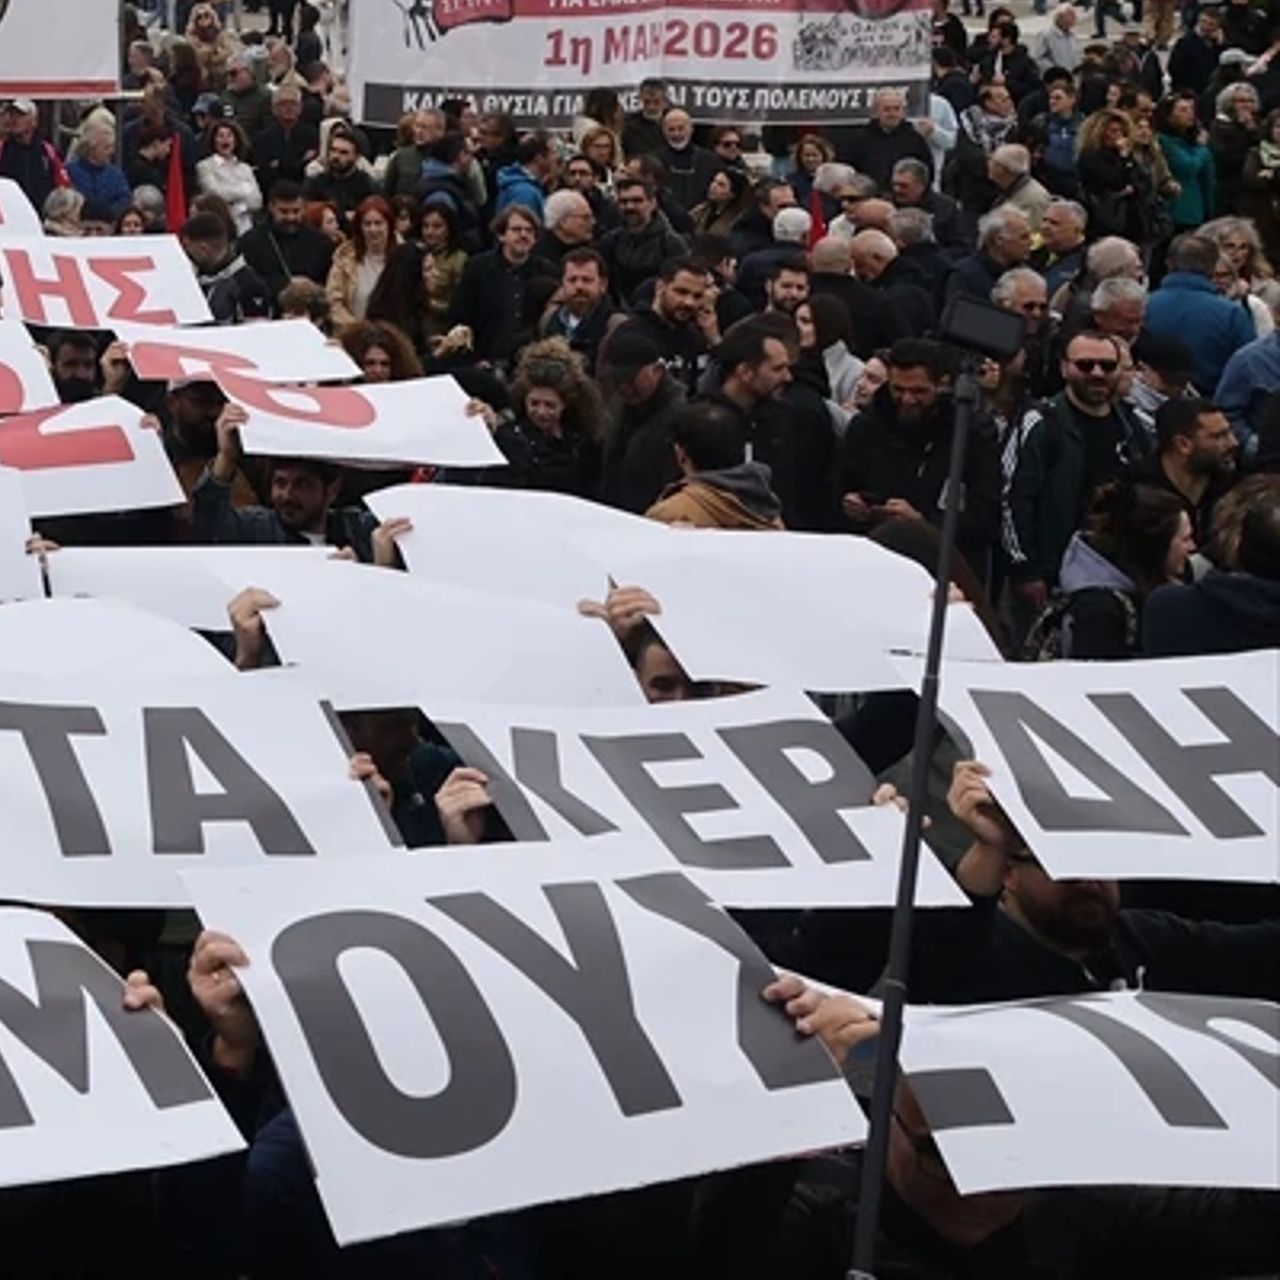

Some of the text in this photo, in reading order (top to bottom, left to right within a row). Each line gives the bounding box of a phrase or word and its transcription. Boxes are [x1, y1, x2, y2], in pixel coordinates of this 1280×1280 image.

[544, 29, 592, 75] 1η
[663, 19, 777, 60] 2026
[692, 87, 749, 108] ΤΟΥΣ
[755, 89, 861, 109] ΠΟΛΕΜΟΥΣ
